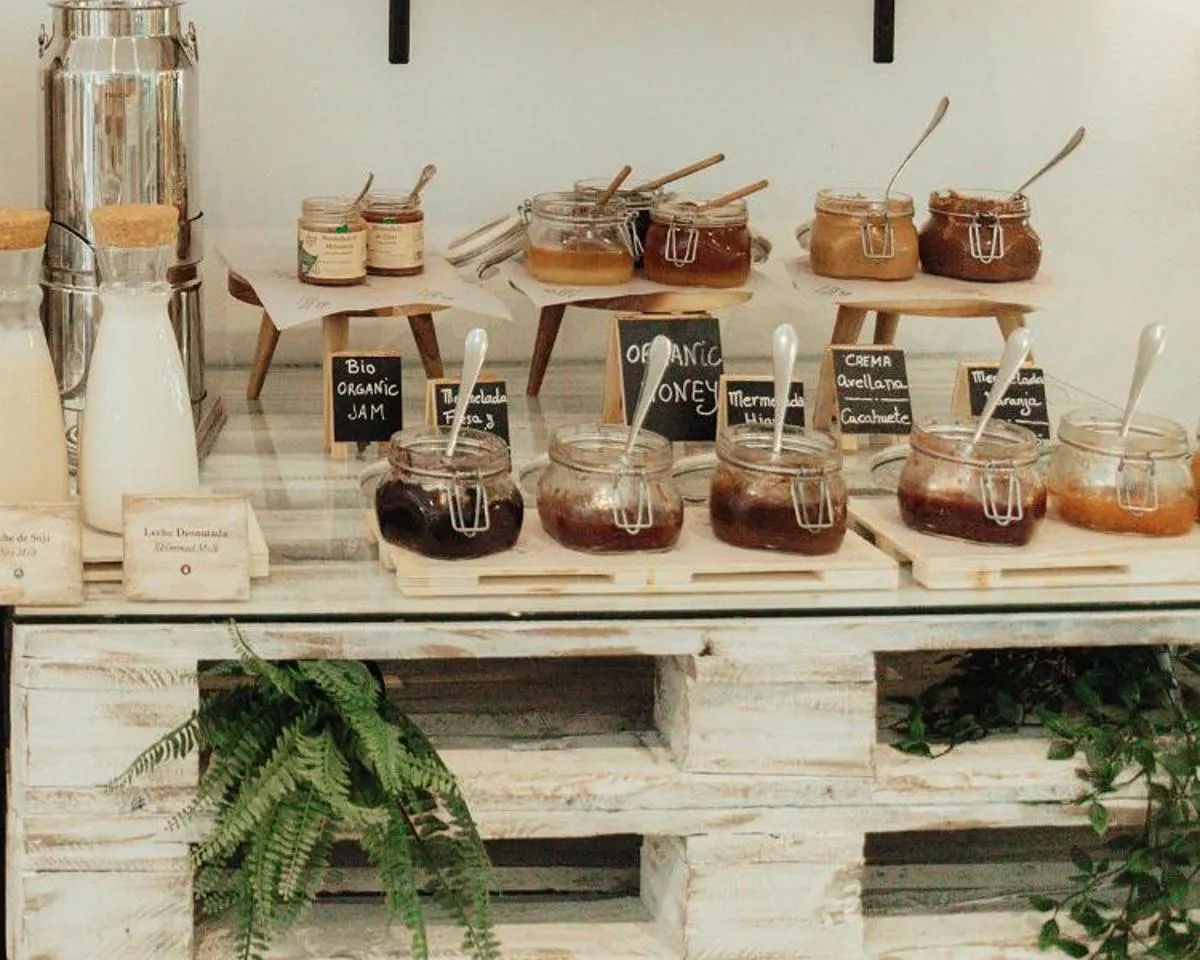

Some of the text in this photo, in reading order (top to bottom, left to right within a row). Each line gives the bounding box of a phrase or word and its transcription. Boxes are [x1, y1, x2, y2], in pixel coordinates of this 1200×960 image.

[345, 359, 377, 375] Bio
[844, 353, 893, 368] CREMA
[641, 378, 719, 416] ONEY
[984, 391, 1043, 417] aranja
[347, 403, 386, 422] JAM
